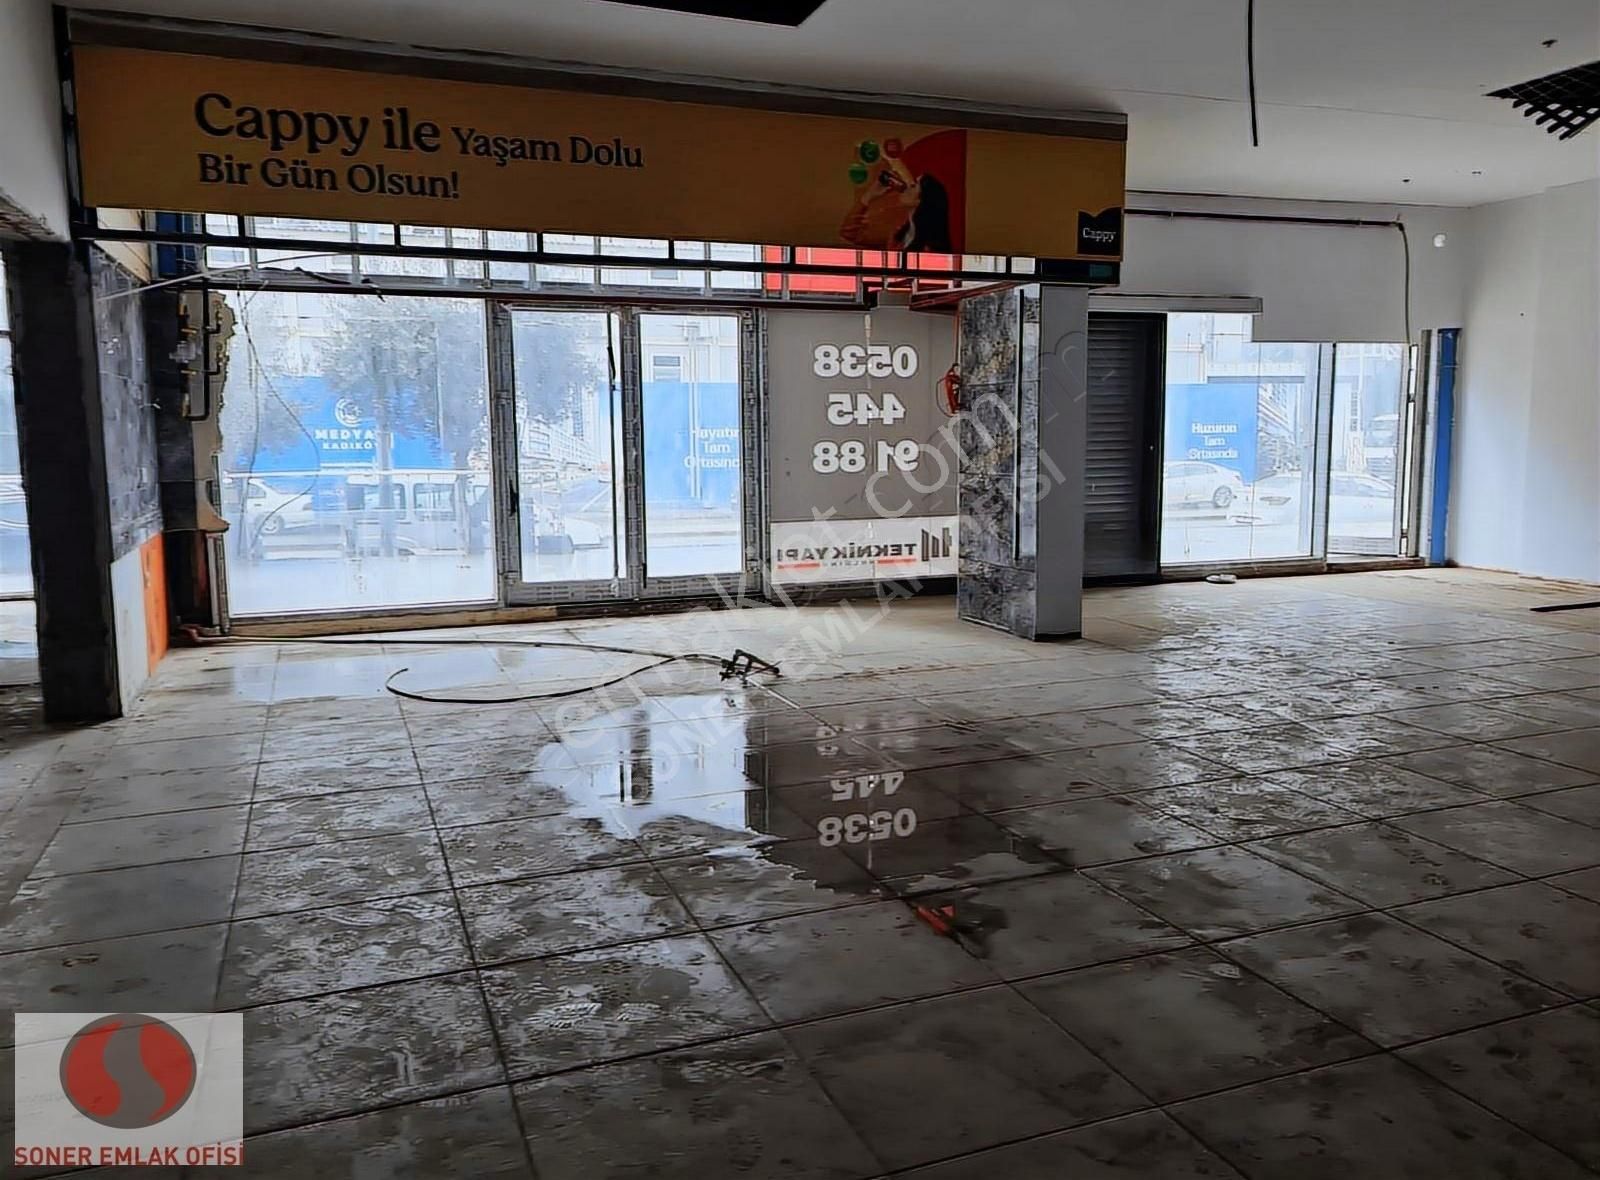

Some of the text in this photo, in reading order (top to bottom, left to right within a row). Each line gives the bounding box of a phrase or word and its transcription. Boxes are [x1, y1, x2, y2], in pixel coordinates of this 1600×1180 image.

[194, 93, 644, 168] Cappy ile Yaşam Dolu
[198, 153, 460, 200] Bir Gün Olsun!
[1082, 227, 1117, 243] Cappy
